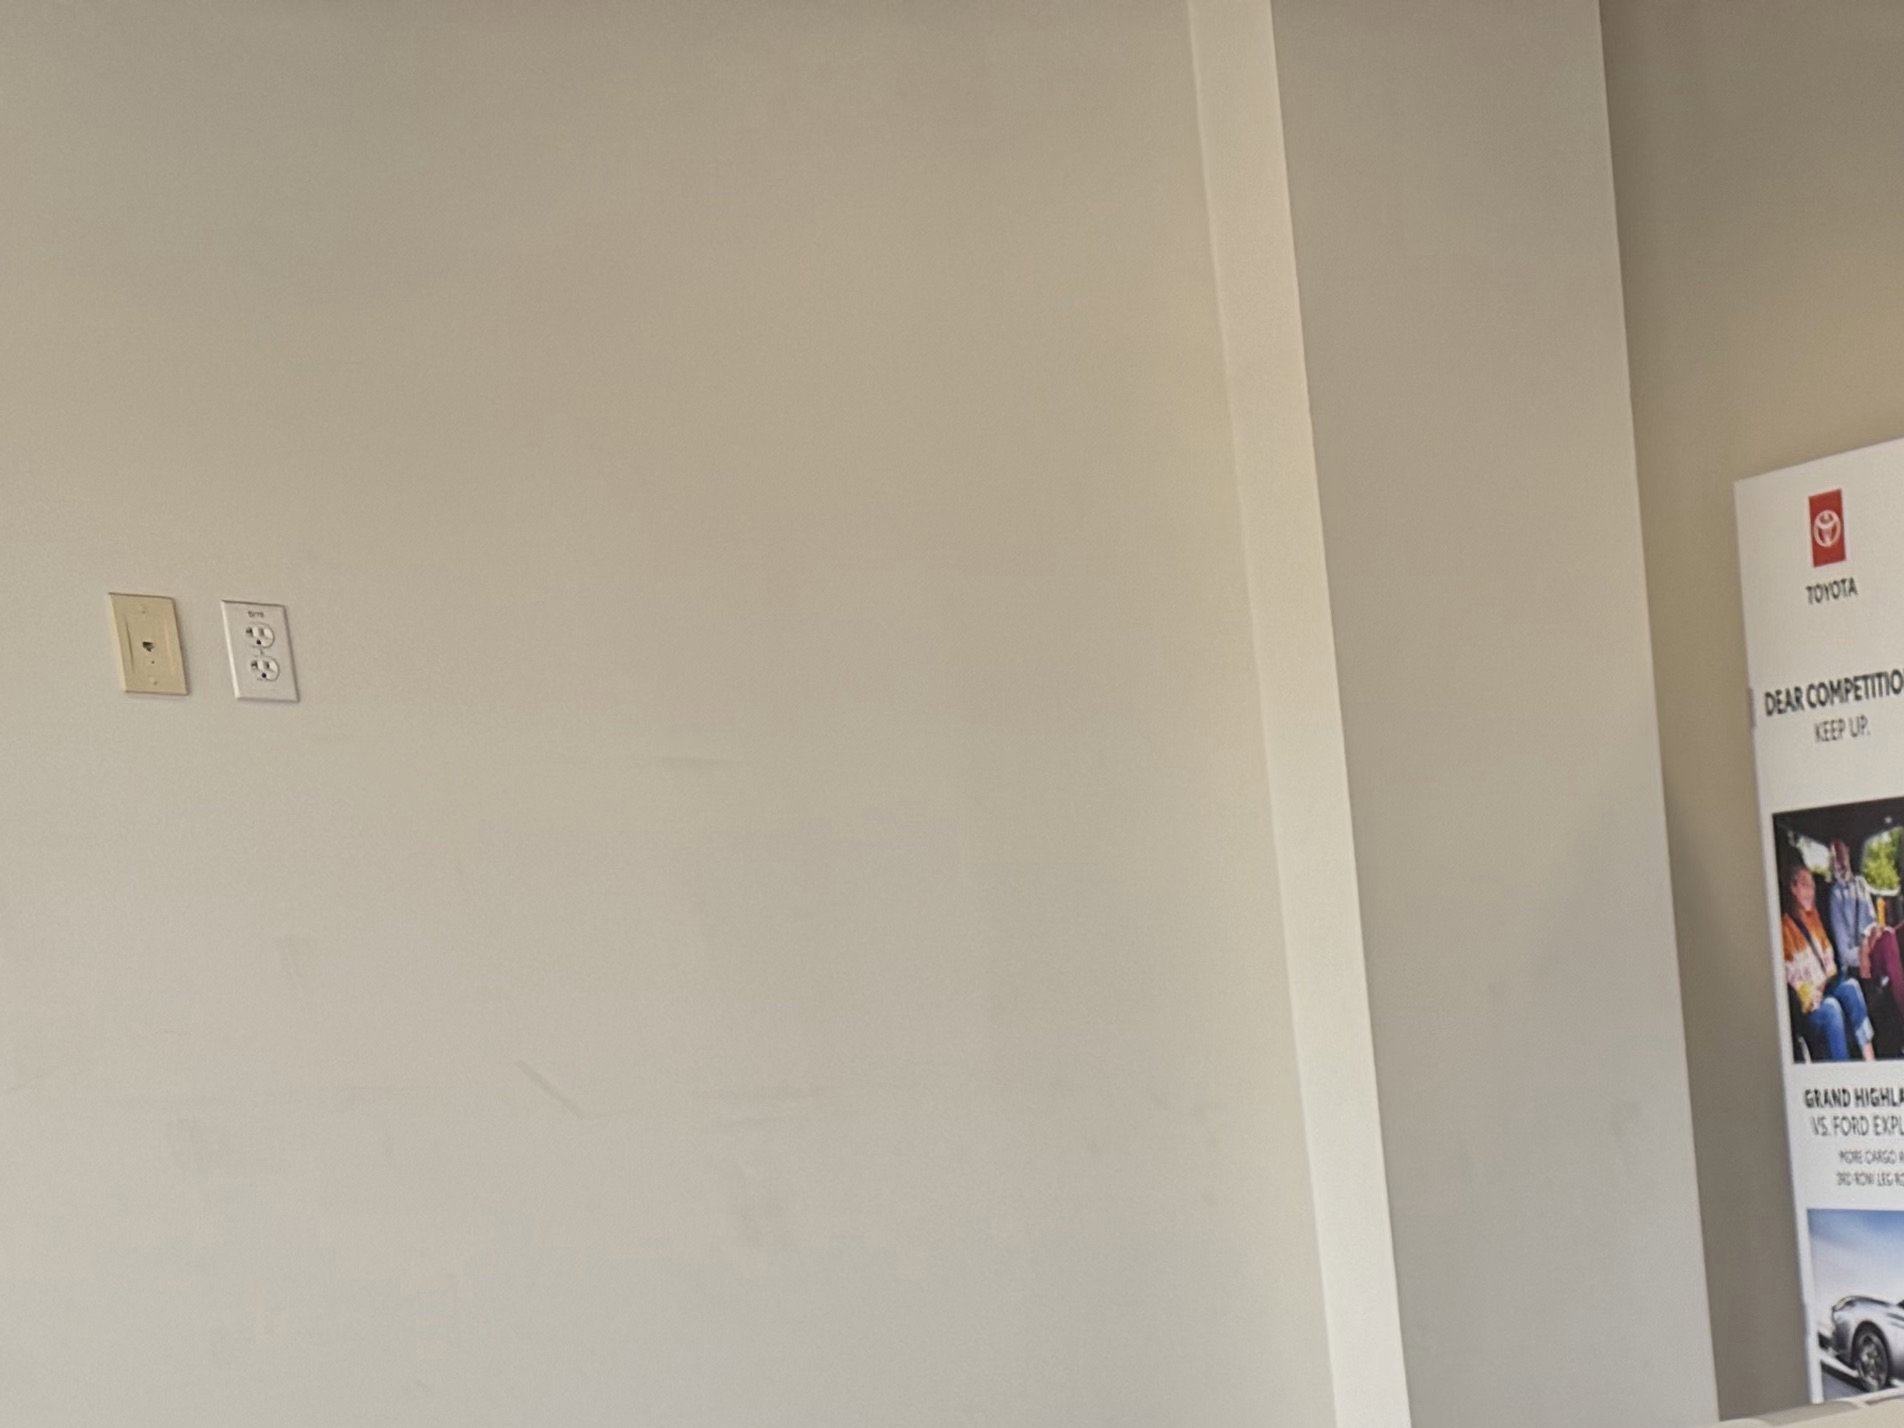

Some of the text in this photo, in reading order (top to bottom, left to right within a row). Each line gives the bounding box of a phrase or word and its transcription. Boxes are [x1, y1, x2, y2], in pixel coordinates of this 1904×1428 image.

[1805, 576, 1859, 605] TOYOTA
[1764, 686, 1804, 717] DEAR
[1814, 714, 1871, 743] KEEP UP.
[1804, 1087, 1851, 1109] GRAND
[1811, 1115, 1831, 1136] VS.
[1832, 1115, 1869, 1136] FORD
